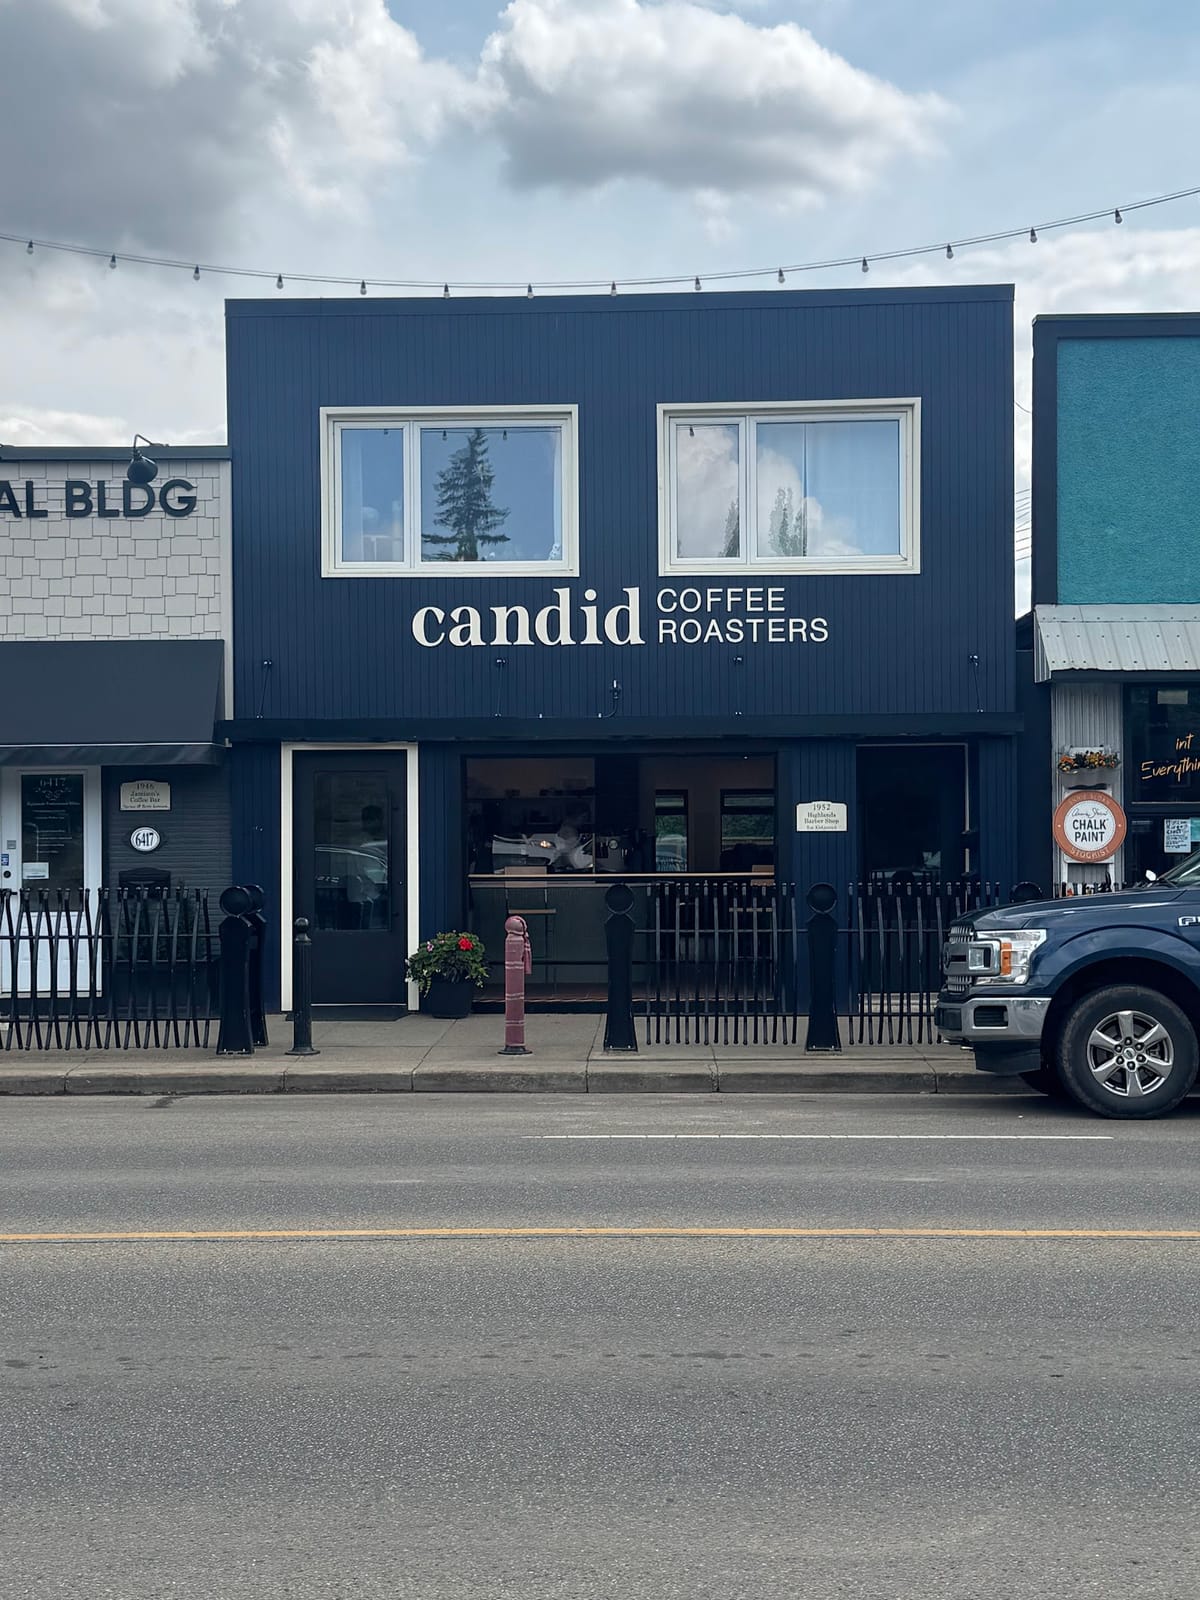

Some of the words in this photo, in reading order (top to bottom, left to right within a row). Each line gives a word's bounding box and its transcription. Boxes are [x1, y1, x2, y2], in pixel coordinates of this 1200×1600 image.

[0, 480, 48, 518] AL
[65, 479, 197, 518] BLDG
[657, 587, 785, 613] COFFEE
[411, 587, 645, 647] candid
[658, 618, 829, 643] ROASTERS
[813, 803, 831, 811] 1952
[1072, 819, 1107, 830] CHALK
[135, 832, 154, 847] 6417
[1074, 831, 1105, 842] PAINT
[1070, 847, 1110, 860] STOCKIST
